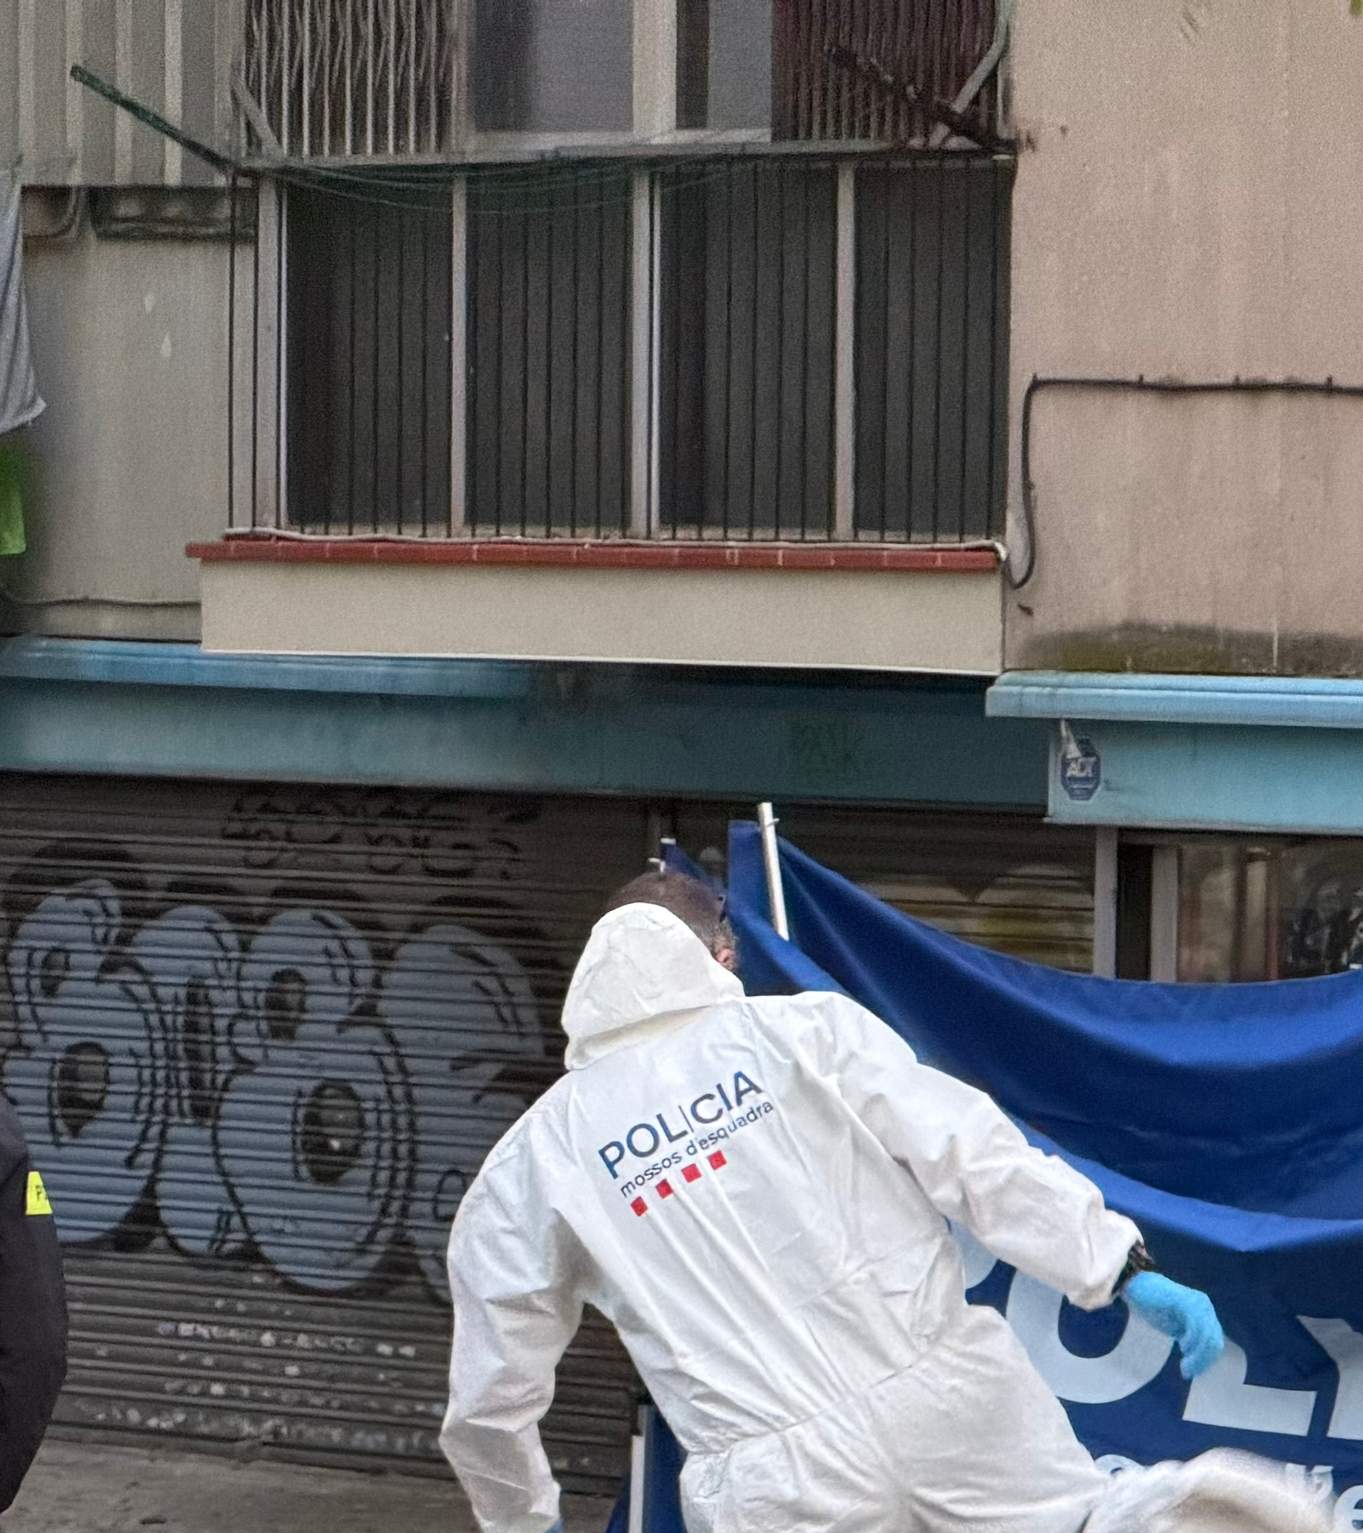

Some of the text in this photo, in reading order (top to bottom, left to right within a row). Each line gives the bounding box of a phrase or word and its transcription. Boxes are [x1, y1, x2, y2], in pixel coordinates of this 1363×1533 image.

[598, 1070, 764, 1180] POLICIA
[620, 1100, 775, 1198] mossos d'esquadra
